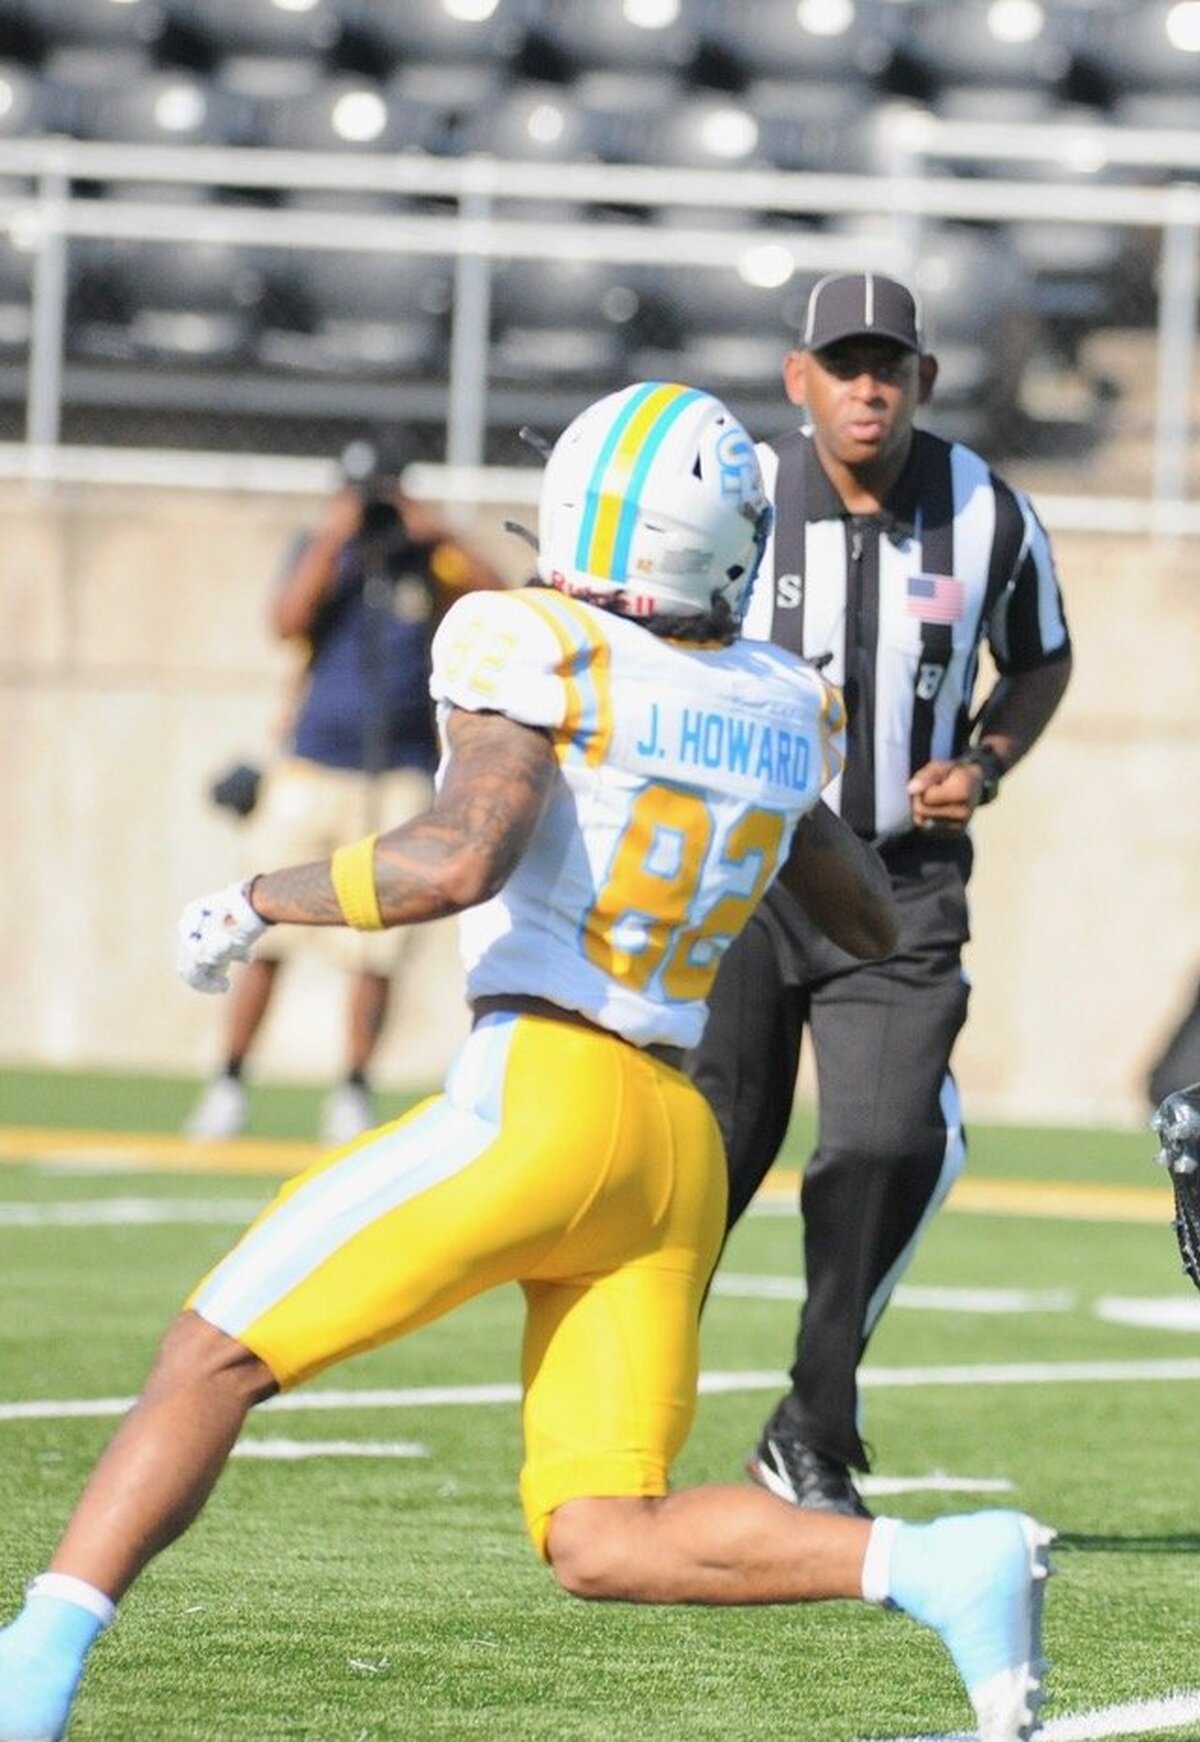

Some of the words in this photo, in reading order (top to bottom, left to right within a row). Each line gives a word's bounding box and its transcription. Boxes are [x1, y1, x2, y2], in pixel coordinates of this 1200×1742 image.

[776, 574, 802, 608] S
[636, 703, 665, 758] J.
[679, 708, 811, 793] HOWARD
[577, 776, 785, 1003] 82
